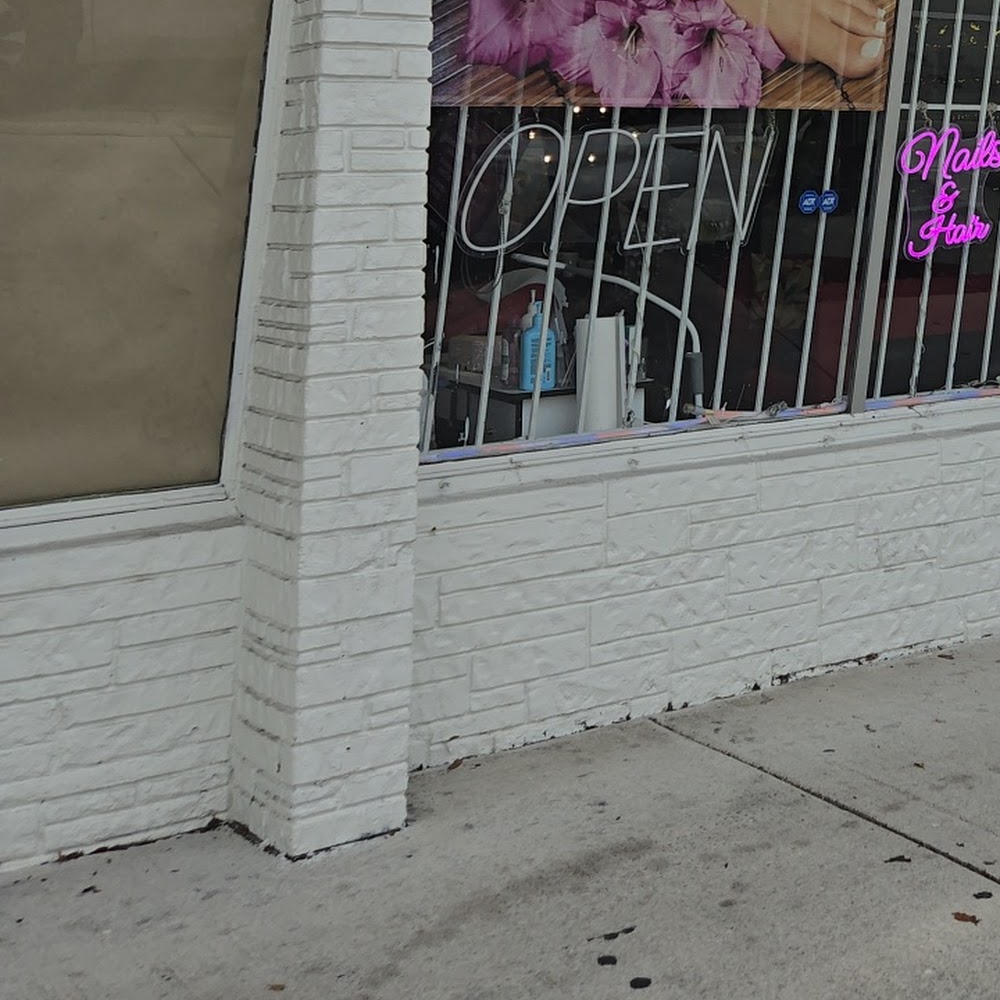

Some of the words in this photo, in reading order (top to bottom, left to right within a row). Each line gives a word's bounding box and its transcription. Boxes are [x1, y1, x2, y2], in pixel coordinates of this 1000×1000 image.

[460, 123, 775, 252] OPEN
[931, 181, 961, 214] &
[908, 212, 991, 259] Hair
